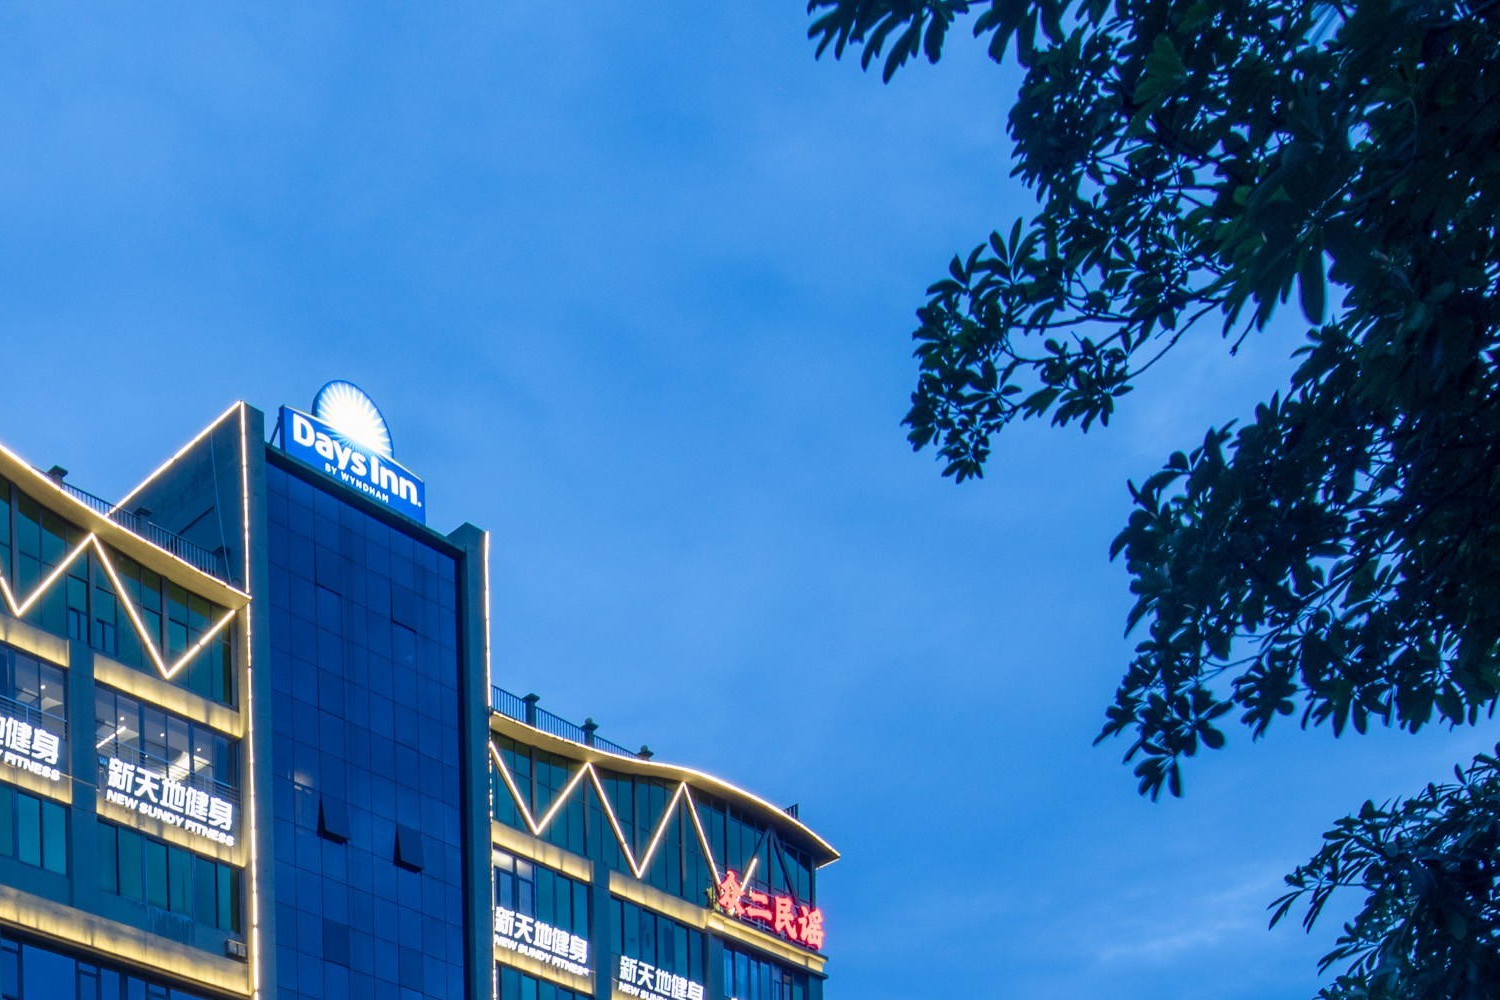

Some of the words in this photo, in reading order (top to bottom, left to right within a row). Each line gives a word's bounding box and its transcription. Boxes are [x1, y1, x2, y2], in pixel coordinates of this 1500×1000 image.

[293, 413, 367, 477] Days
[325, 462, 337, 475] BY
[341, 471, 389, 503] WYNDHAM
[4, 751, 61, 782] FITNESS
[107, 757, 233, 831] 新天地健身
[106, 789, 139, 811] NEW
[138, 802, 185, 828] SUNDY
[185, 818, 235, 847] FITNESS
[495, 906, 588, 964] 新天地健身
[718, 869, 823, 950] 众二民谣
[494, 934, 518, 951] NEW
[518, 943, 553, 964] SUNDY
[552, 956, 590, 977] FITNESS
[618, 981, 640, 997] NEW
